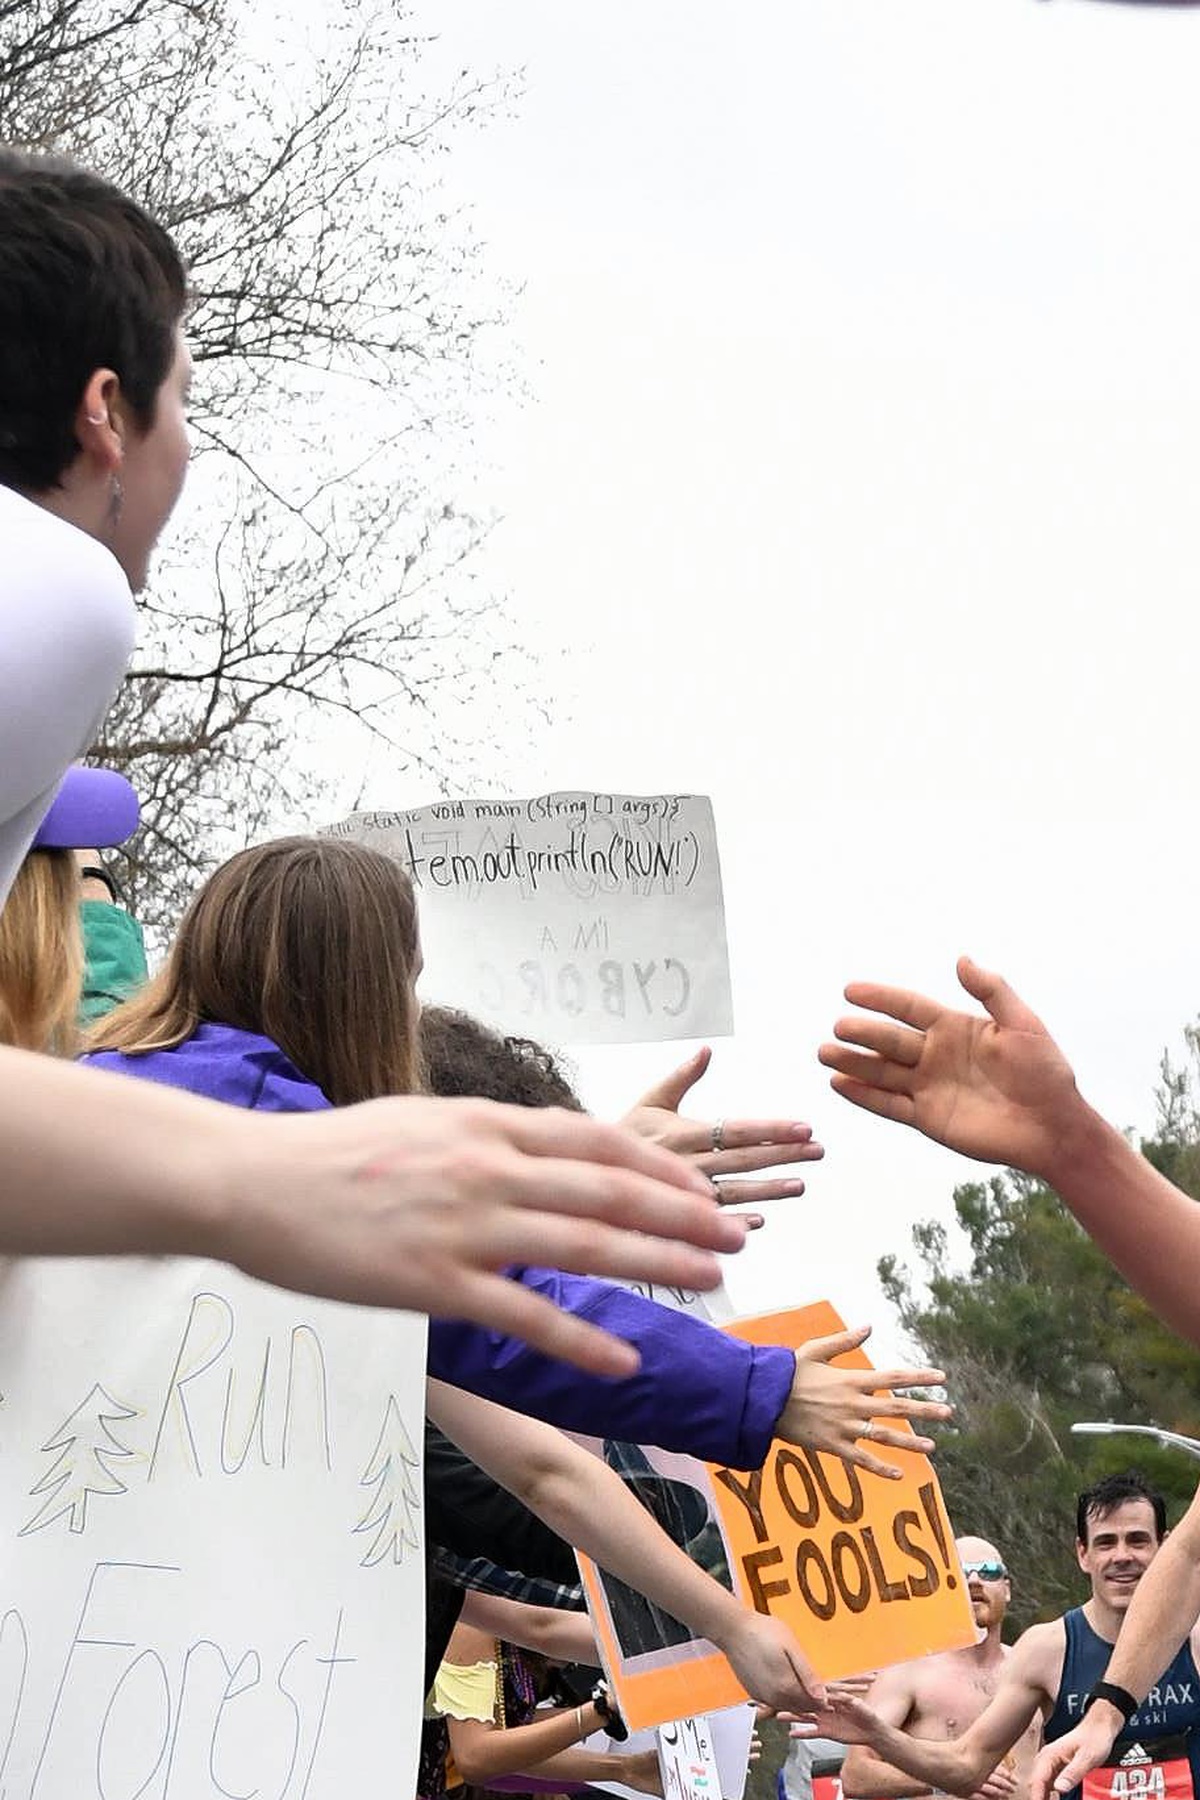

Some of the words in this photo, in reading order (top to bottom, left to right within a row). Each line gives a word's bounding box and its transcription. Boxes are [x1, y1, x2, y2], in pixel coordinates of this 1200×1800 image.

[363, 808, 422, 832] static
[431, 800, 466, 820] void
[475, 803, 521, 818] main
[148, 1292, 331, 1483] Run
[716, 1440, 864, 1544] YOU
[740, 1482, 958, 1622] FOOLS!
